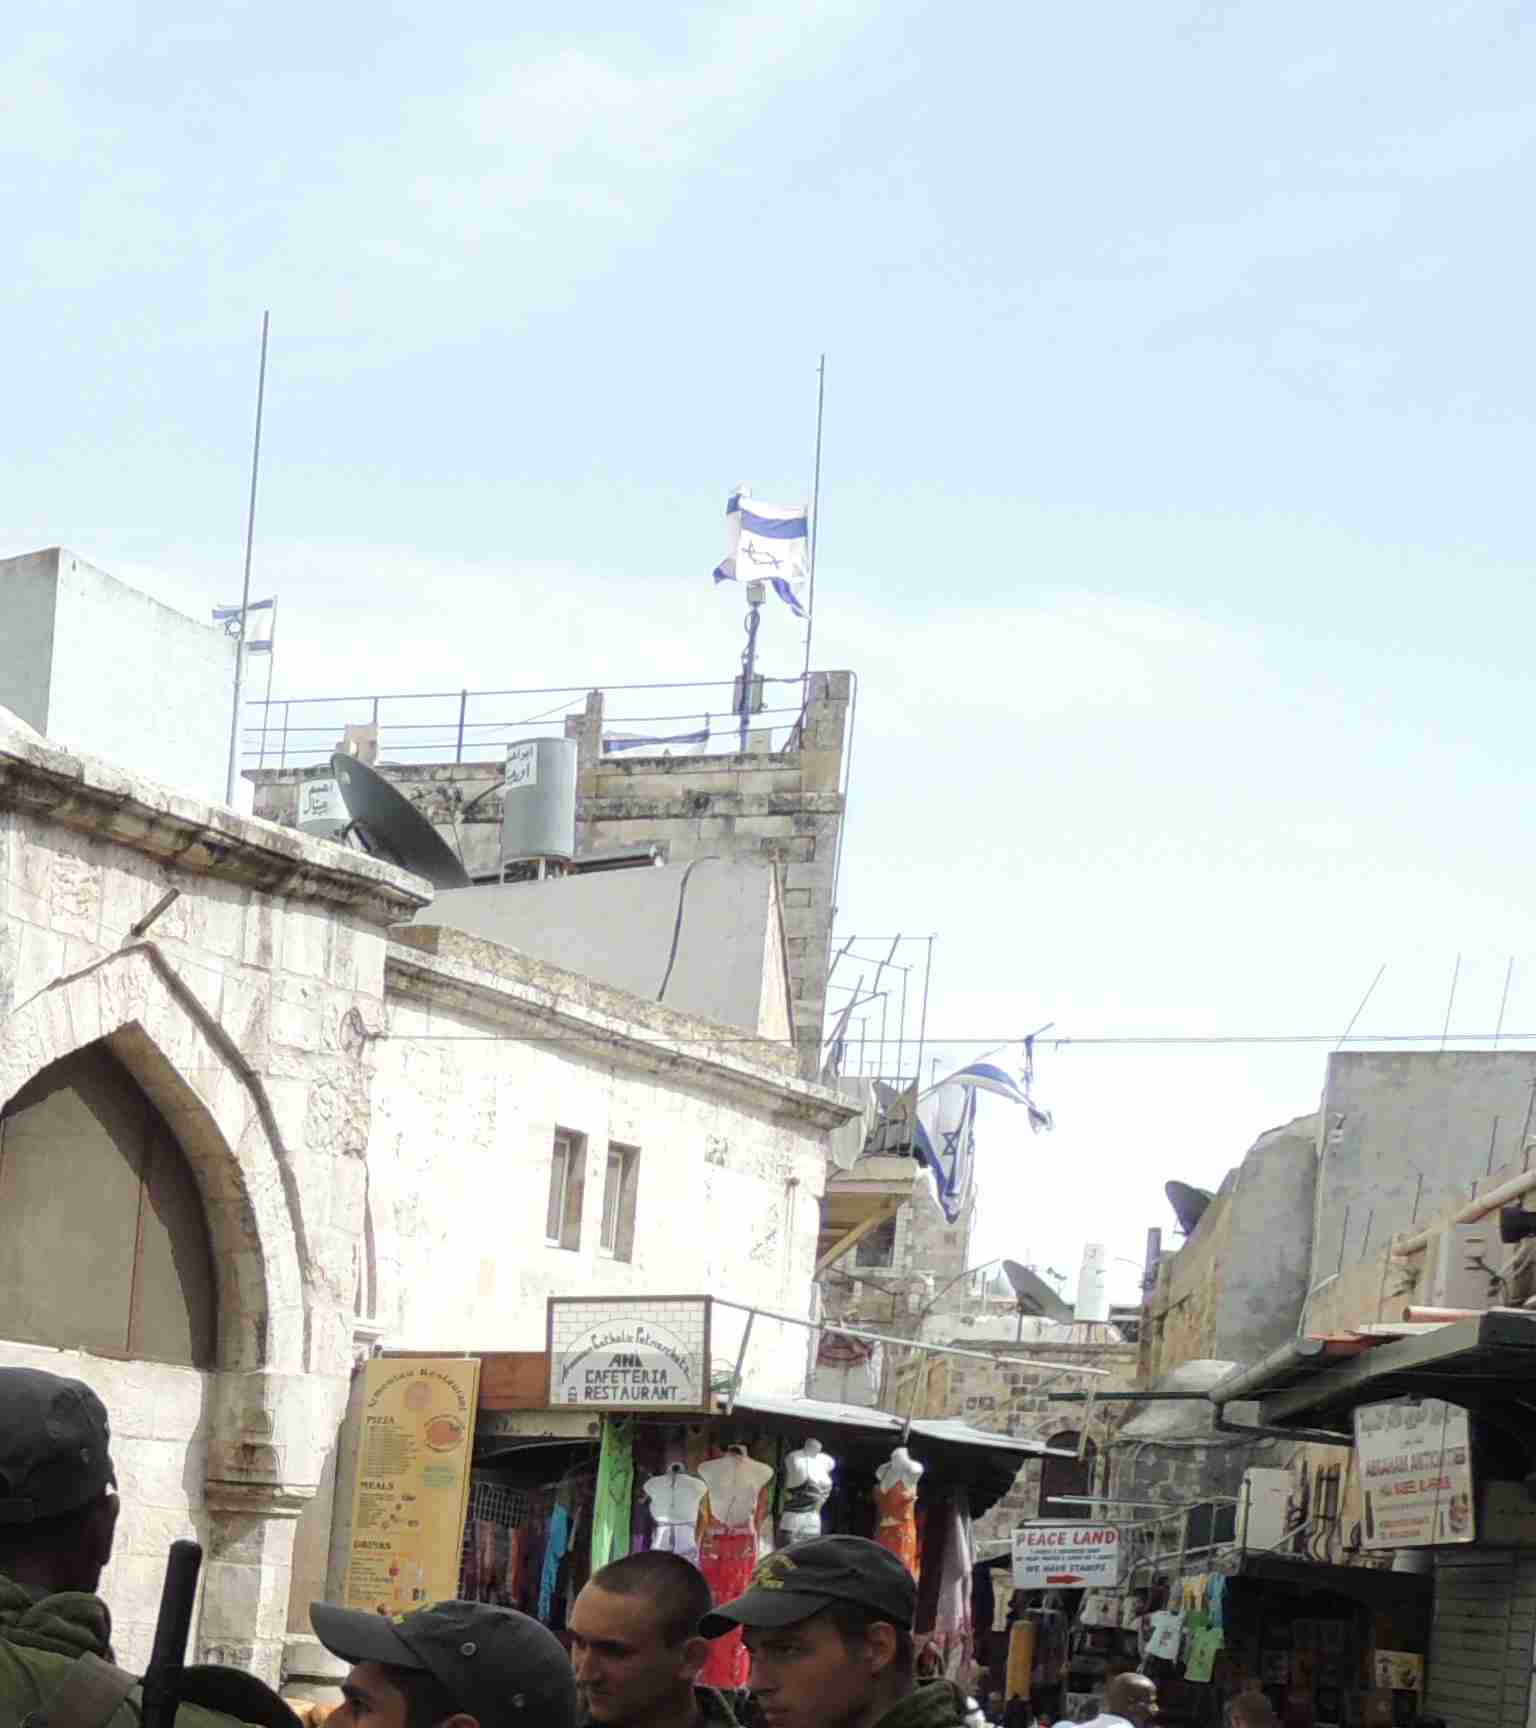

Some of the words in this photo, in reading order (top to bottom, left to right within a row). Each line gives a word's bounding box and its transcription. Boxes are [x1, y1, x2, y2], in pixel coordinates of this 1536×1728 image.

[584, 1368, 668, 1384] CAFETERIA
[584, 1384, 680, 1401] RESTAURANT
[1016, 1531, 1067, 1547] PEACE
[1072, 1529, 1116, 1545] LAND
